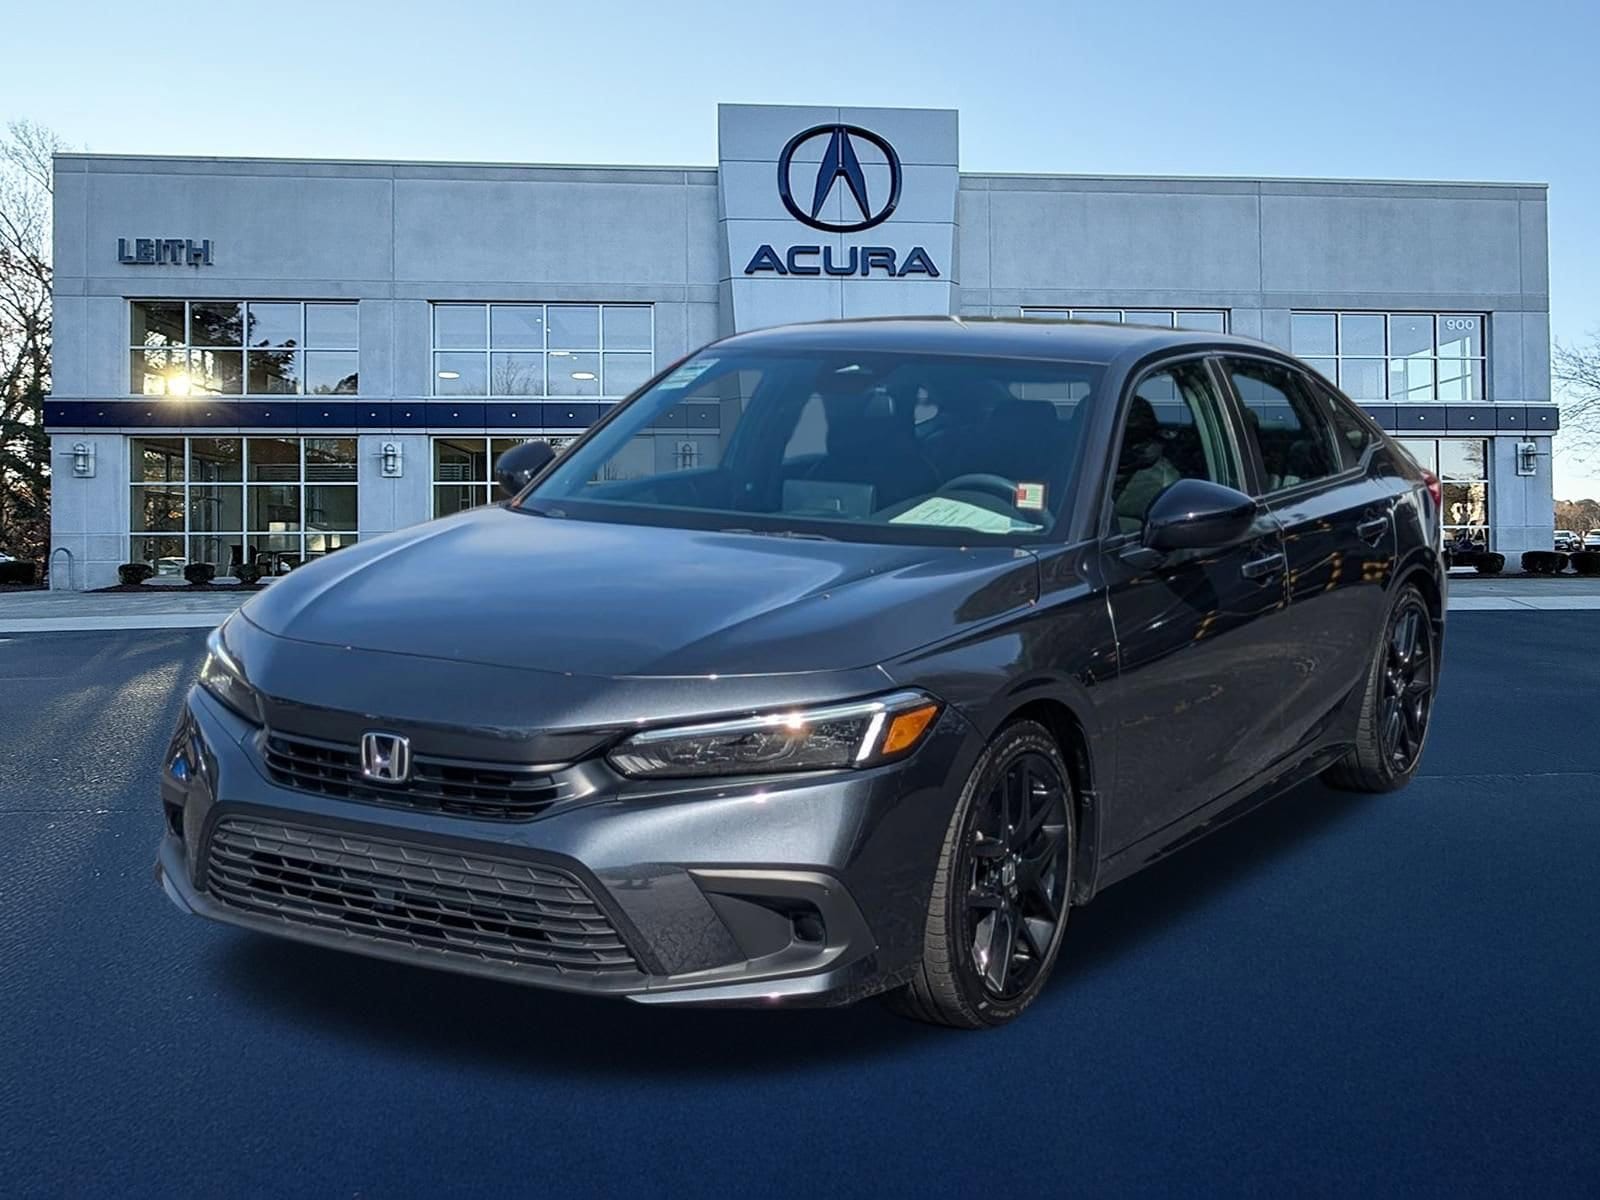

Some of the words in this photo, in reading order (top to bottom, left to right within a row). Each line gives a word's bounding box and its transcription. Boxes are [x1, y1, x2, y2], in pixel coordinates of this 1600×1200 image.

[118, 238, 213, 265] LEITH
[744, 244, 940, 277] ACURA
[1446, 319, 1474, 330] 900
